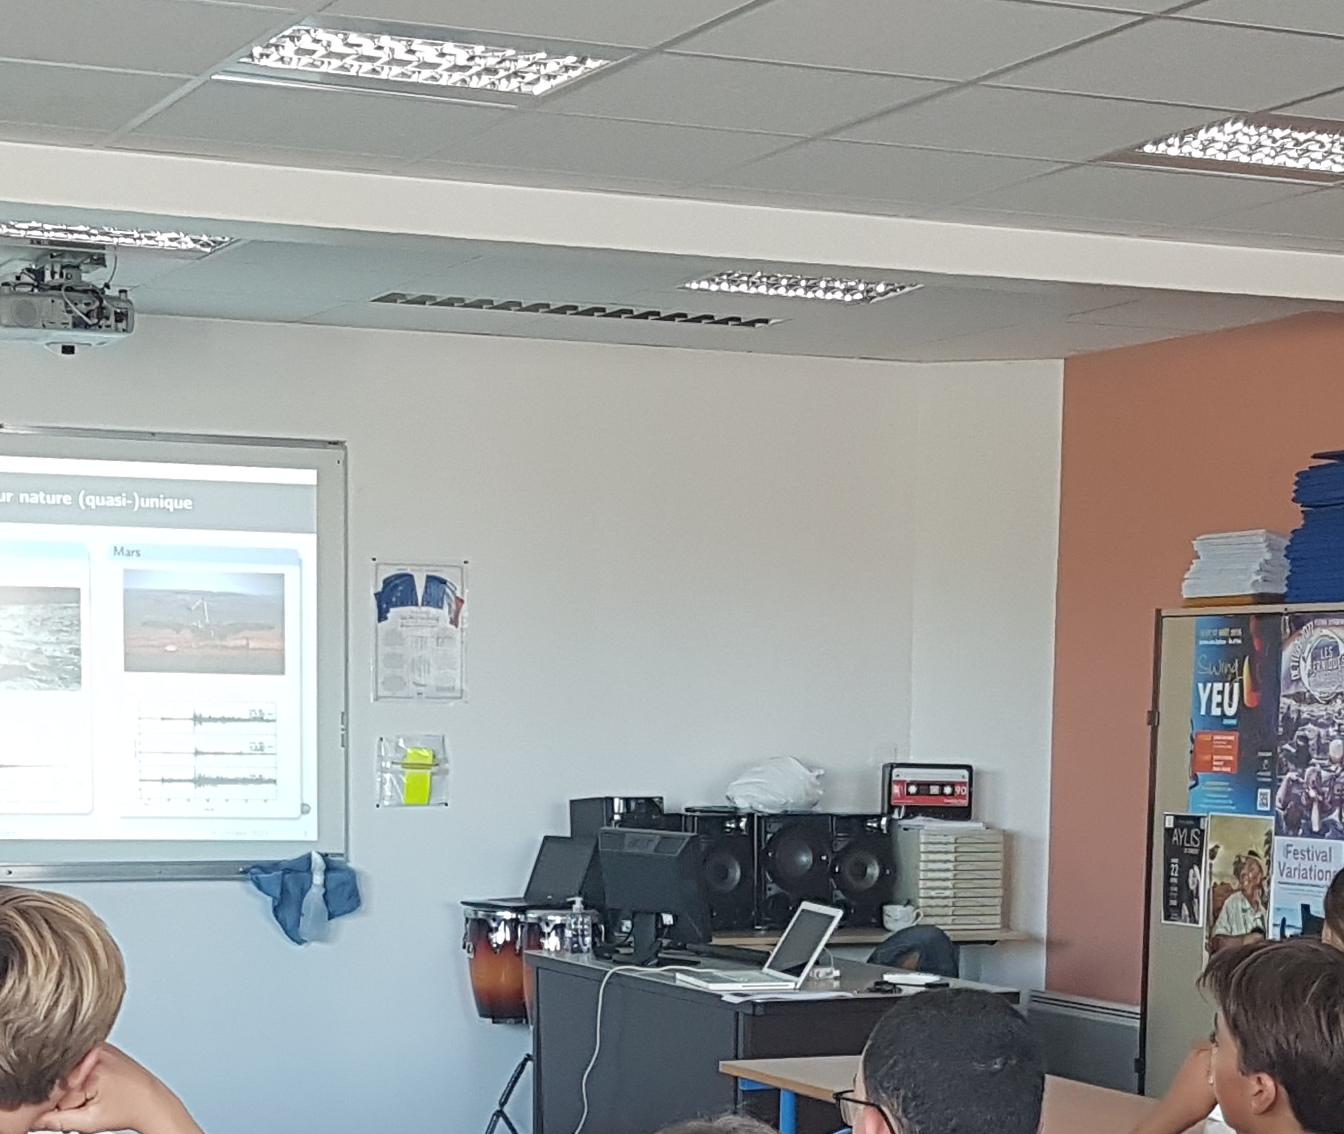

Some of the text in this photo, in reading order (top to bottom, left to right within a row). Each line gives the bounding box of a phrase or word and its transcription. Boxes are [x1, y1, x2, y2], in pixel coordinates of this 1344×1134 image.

[19, 490, 72, 505] nature
[78, 490, 193, 512] (quasi-)unique
[113, 546, 141, 558] Mars
[1197, 682, 1240, 716] YEU
[955, 785, 968, 797] 90
[1285, 843, 1332, 863] Festival
